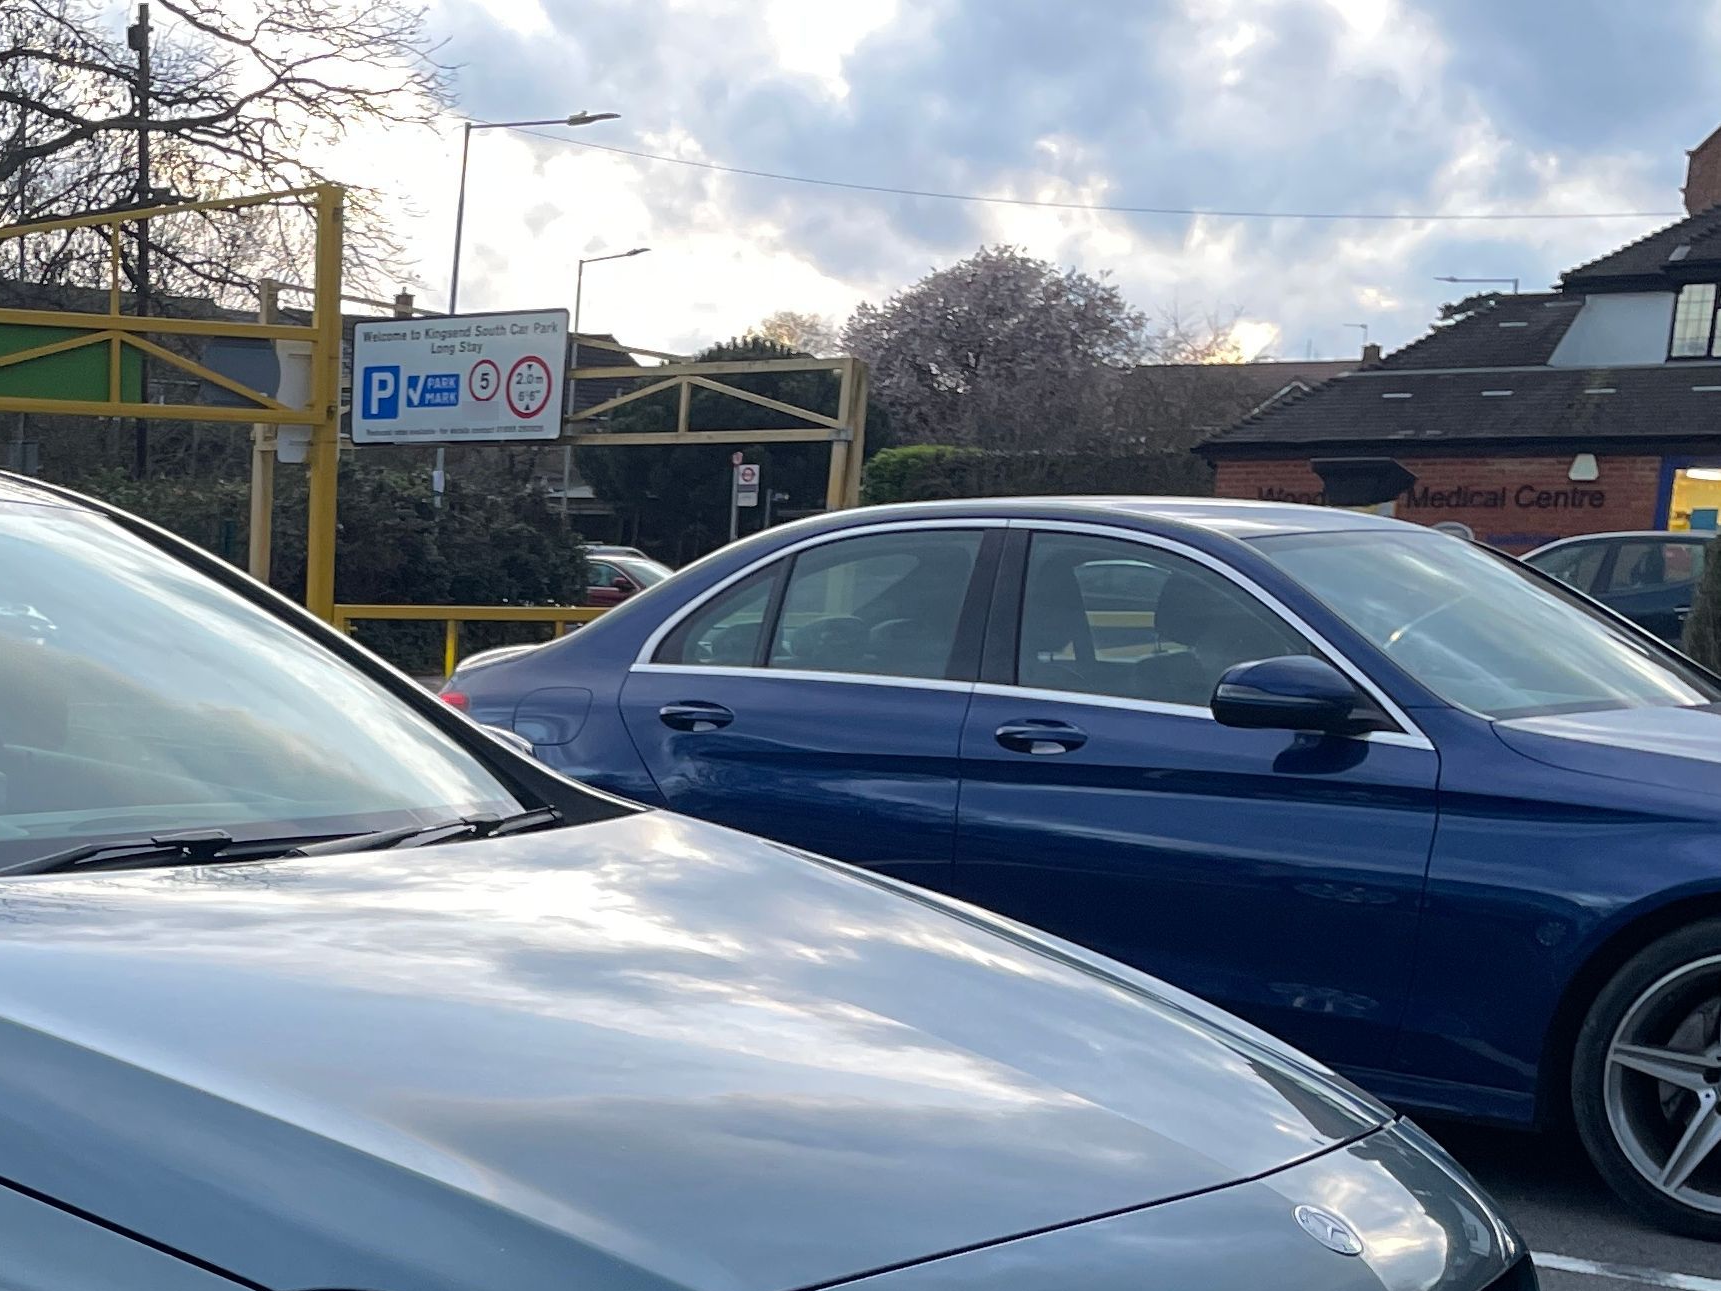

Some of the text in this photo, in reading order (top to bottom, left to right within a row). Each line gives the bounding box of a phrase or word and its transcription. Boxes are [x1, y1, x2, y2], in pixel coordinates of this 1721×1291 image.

[363, 321, 558, 342] Welcome to Kingsend South Car Park
[430, 341, 483, 355] Long Stay
[427, 376, 457, 390] PARK
[480, 373, 490, 390] 5
[371, 371, 395, 415] P
[424, 392, 458, 405] MARK
[1406, 485, 1507, 509] Medical
[1514, 484, 1606, 509] Centre
